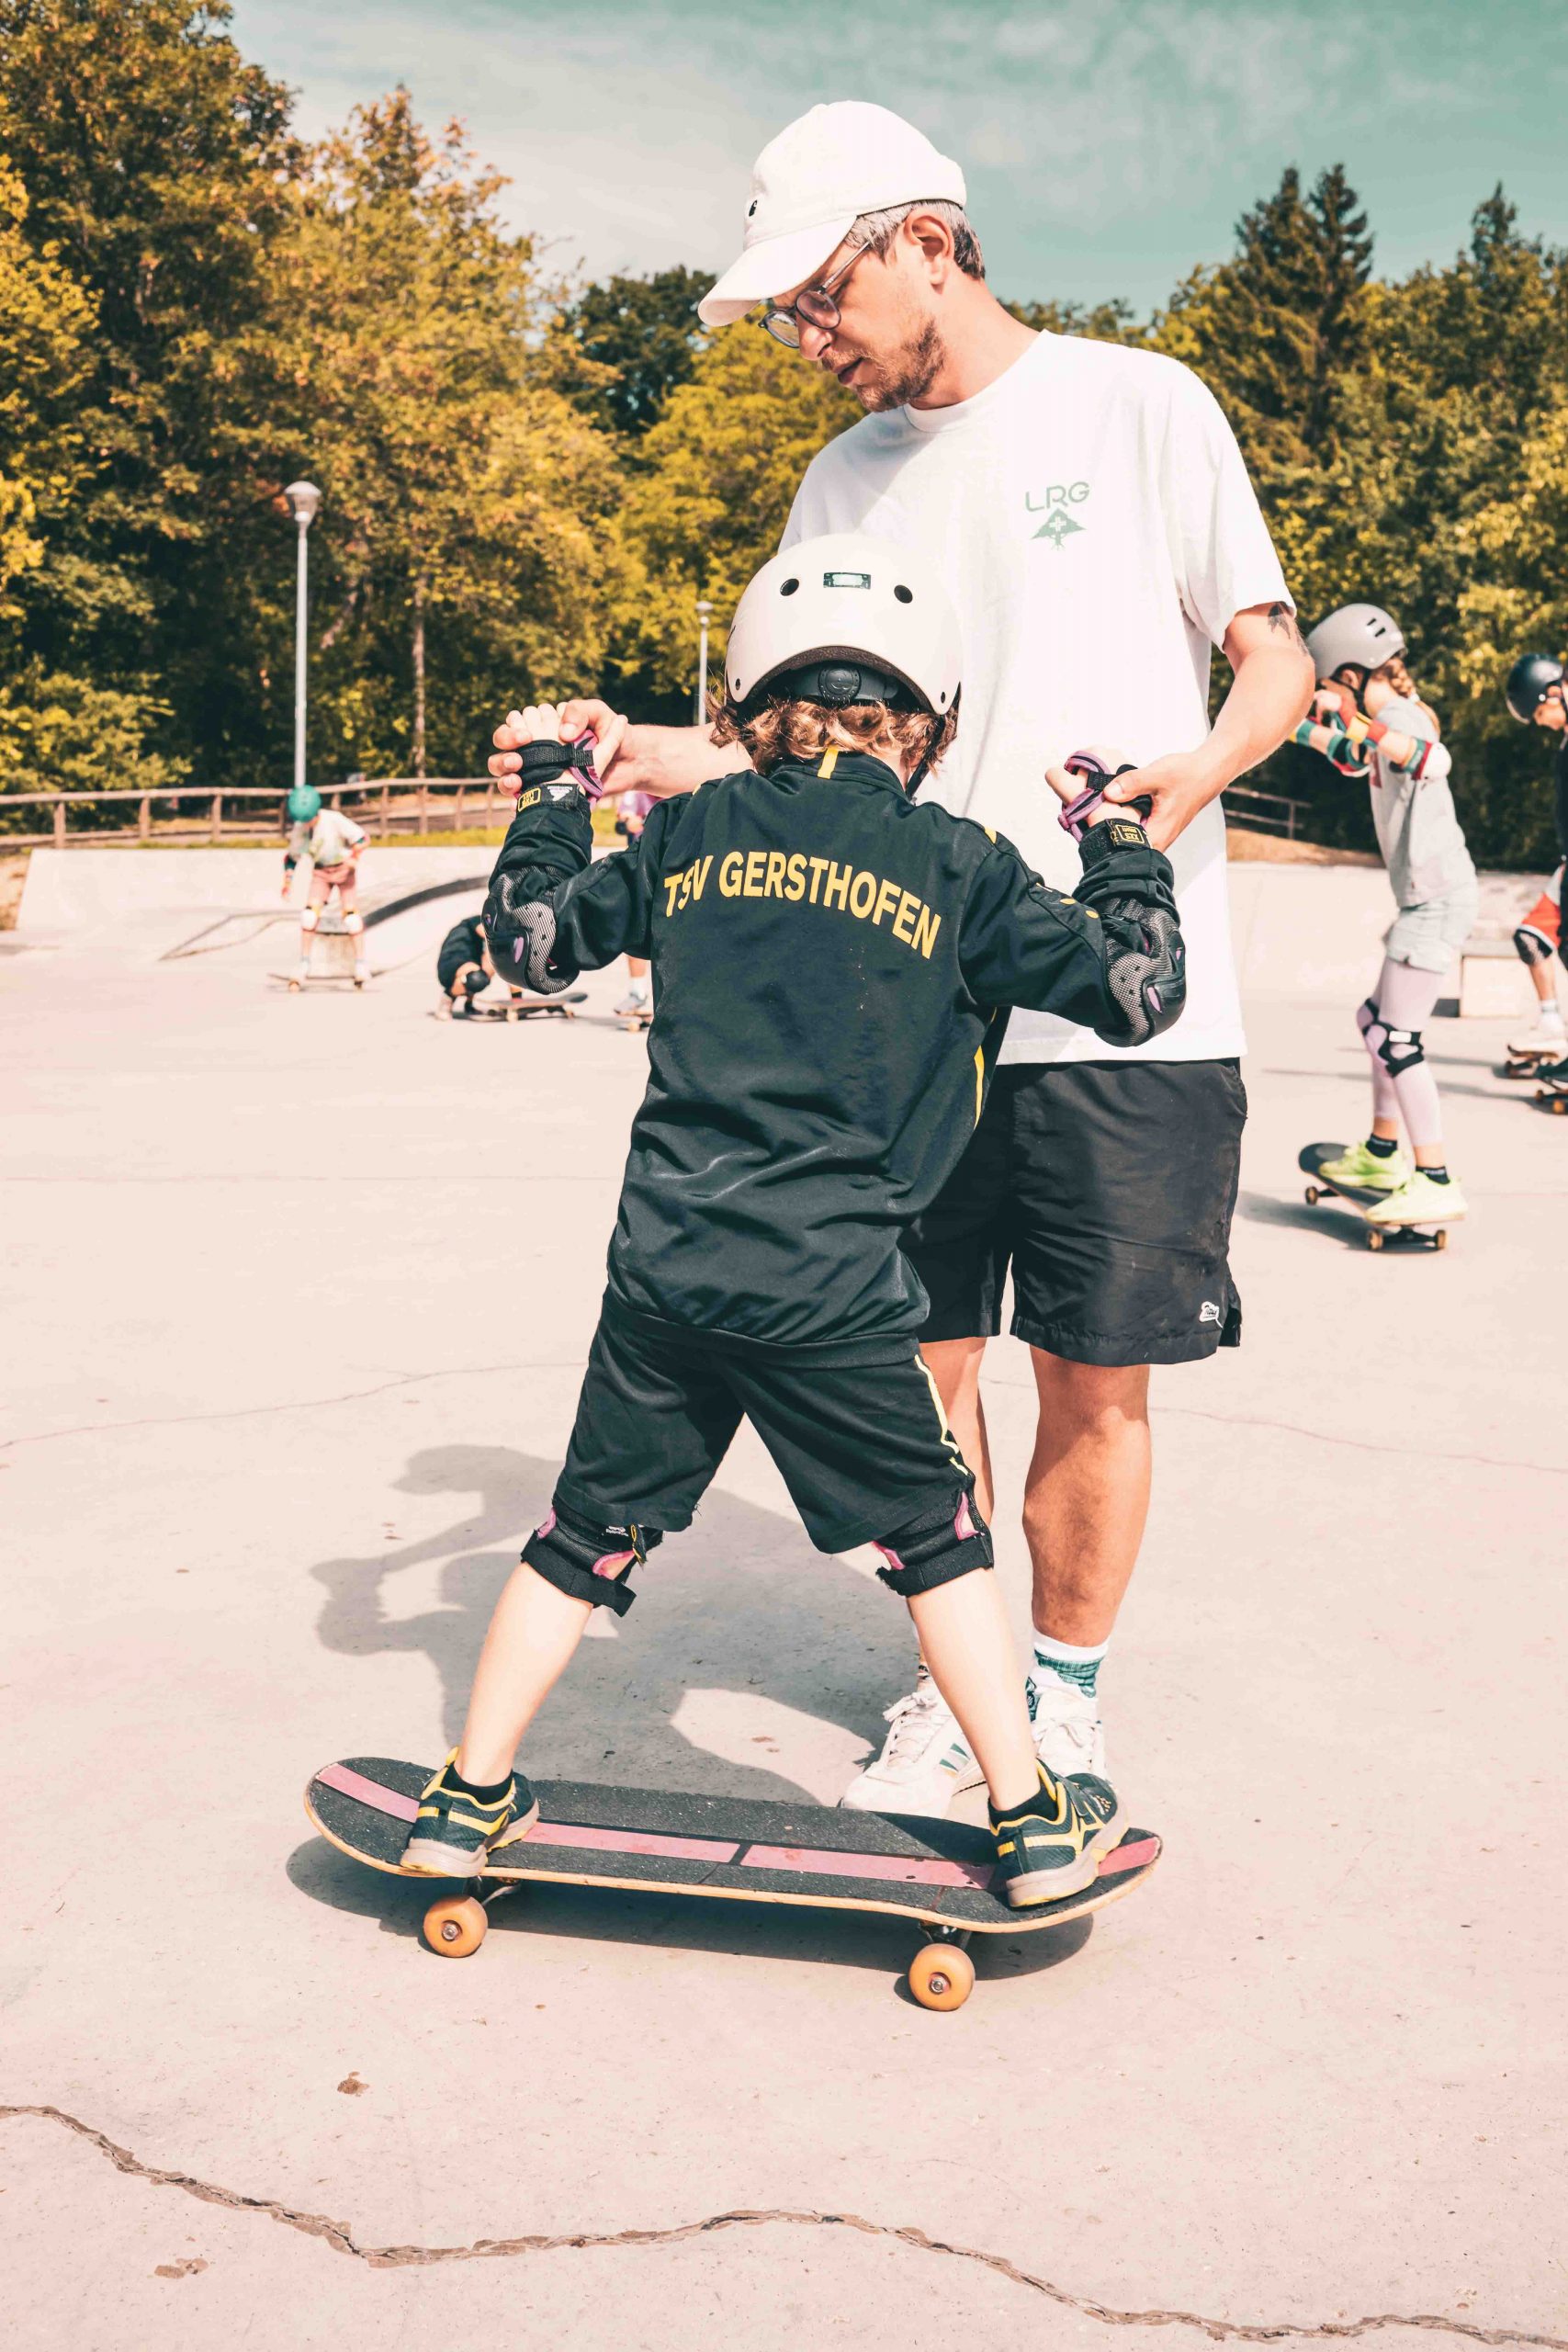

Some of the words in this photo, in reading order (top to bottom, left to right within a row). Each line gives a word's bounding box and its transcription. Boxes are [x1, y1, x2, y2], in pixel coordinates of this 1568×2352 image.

[1025, 481, 1090, 512] LRG
[663, 854, 714, 917] TSV
[718, 851, 942, 959] GERSTHOFEN
